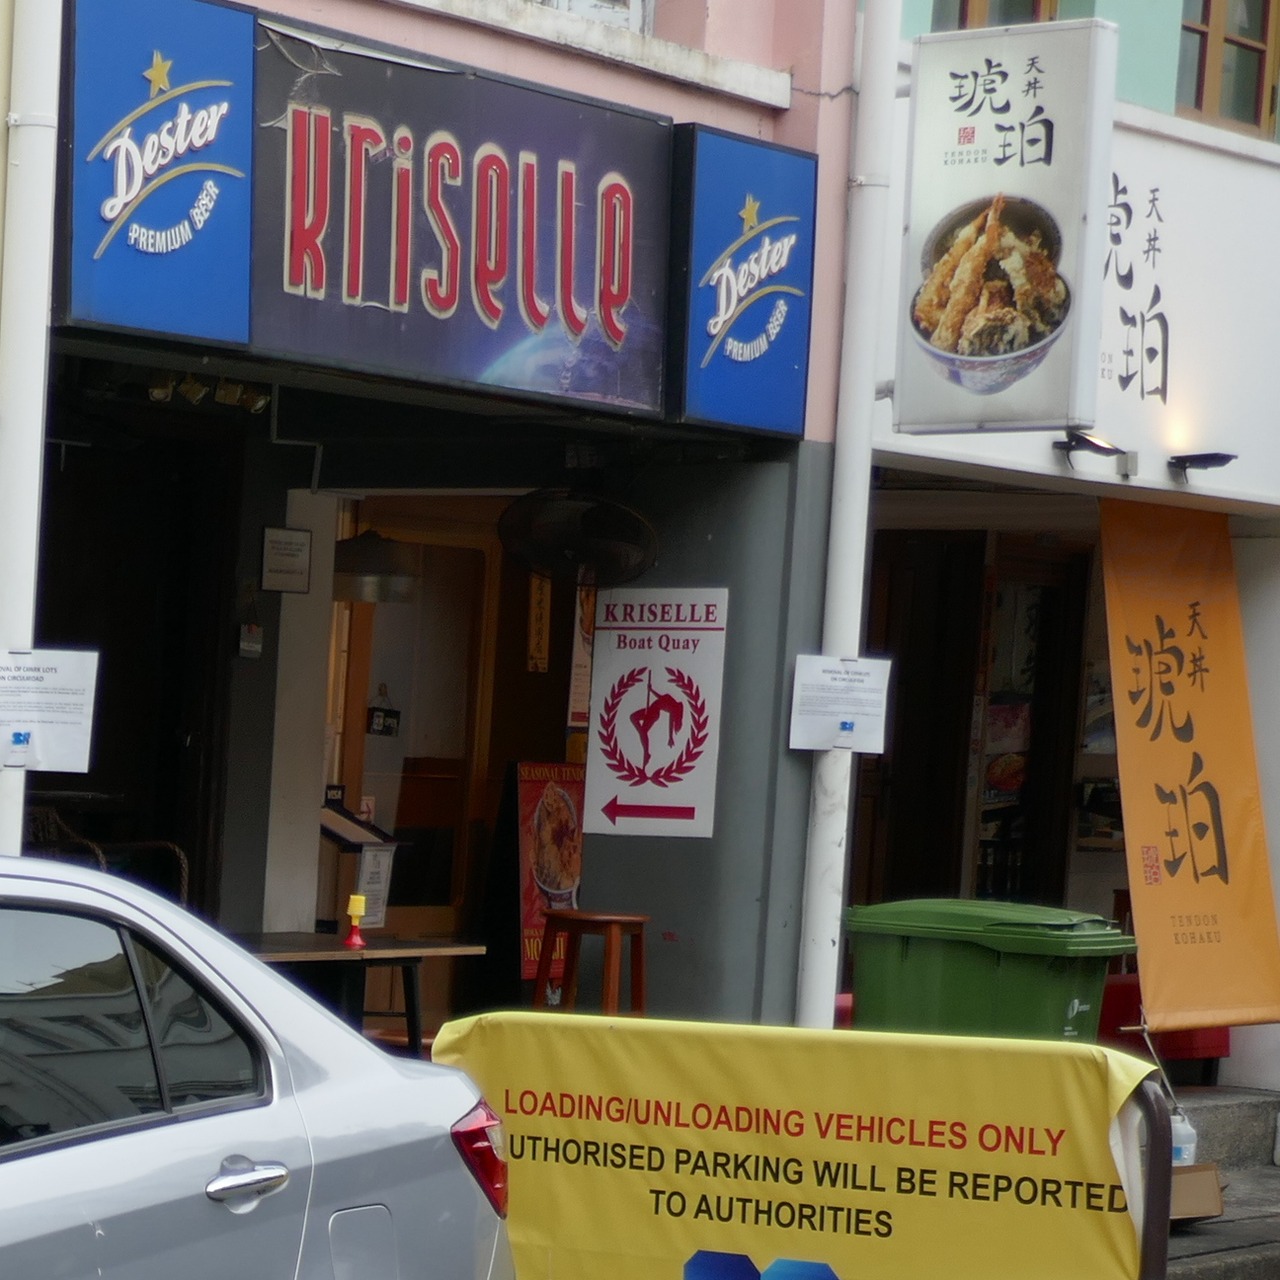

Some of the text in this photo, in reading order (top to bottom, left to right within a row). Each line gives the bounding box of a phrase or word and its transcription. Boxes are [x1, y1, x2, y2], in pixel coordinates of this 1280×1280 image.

[101, 102, 229, 221] Dester
[943, 157, 988, 166] KOHAKU
[944, 149, 988, 158] TENDON
[128, 180, 220, 253] PREMIUM BEER
[707, 234, 797, 336] Dester
[724, 299, 789, 362] PREMIUM BEER
[603, 603, 718, 624] KRISELLE
[616, 634, 700, 654] Boat Quay
[1170, 914, 1219, 928] TENDON
[1173, 930, 1222, 945] KOHAKU
[504, 1089, 1066, 1157] LOADING/UNLOADING VEHICLES ONLY
[509, 1134, 1128, 1214] UTHORISED PARKING WILL BE REPORTED
[649, 1189, 893, 1239] TO AUTHORITIES
